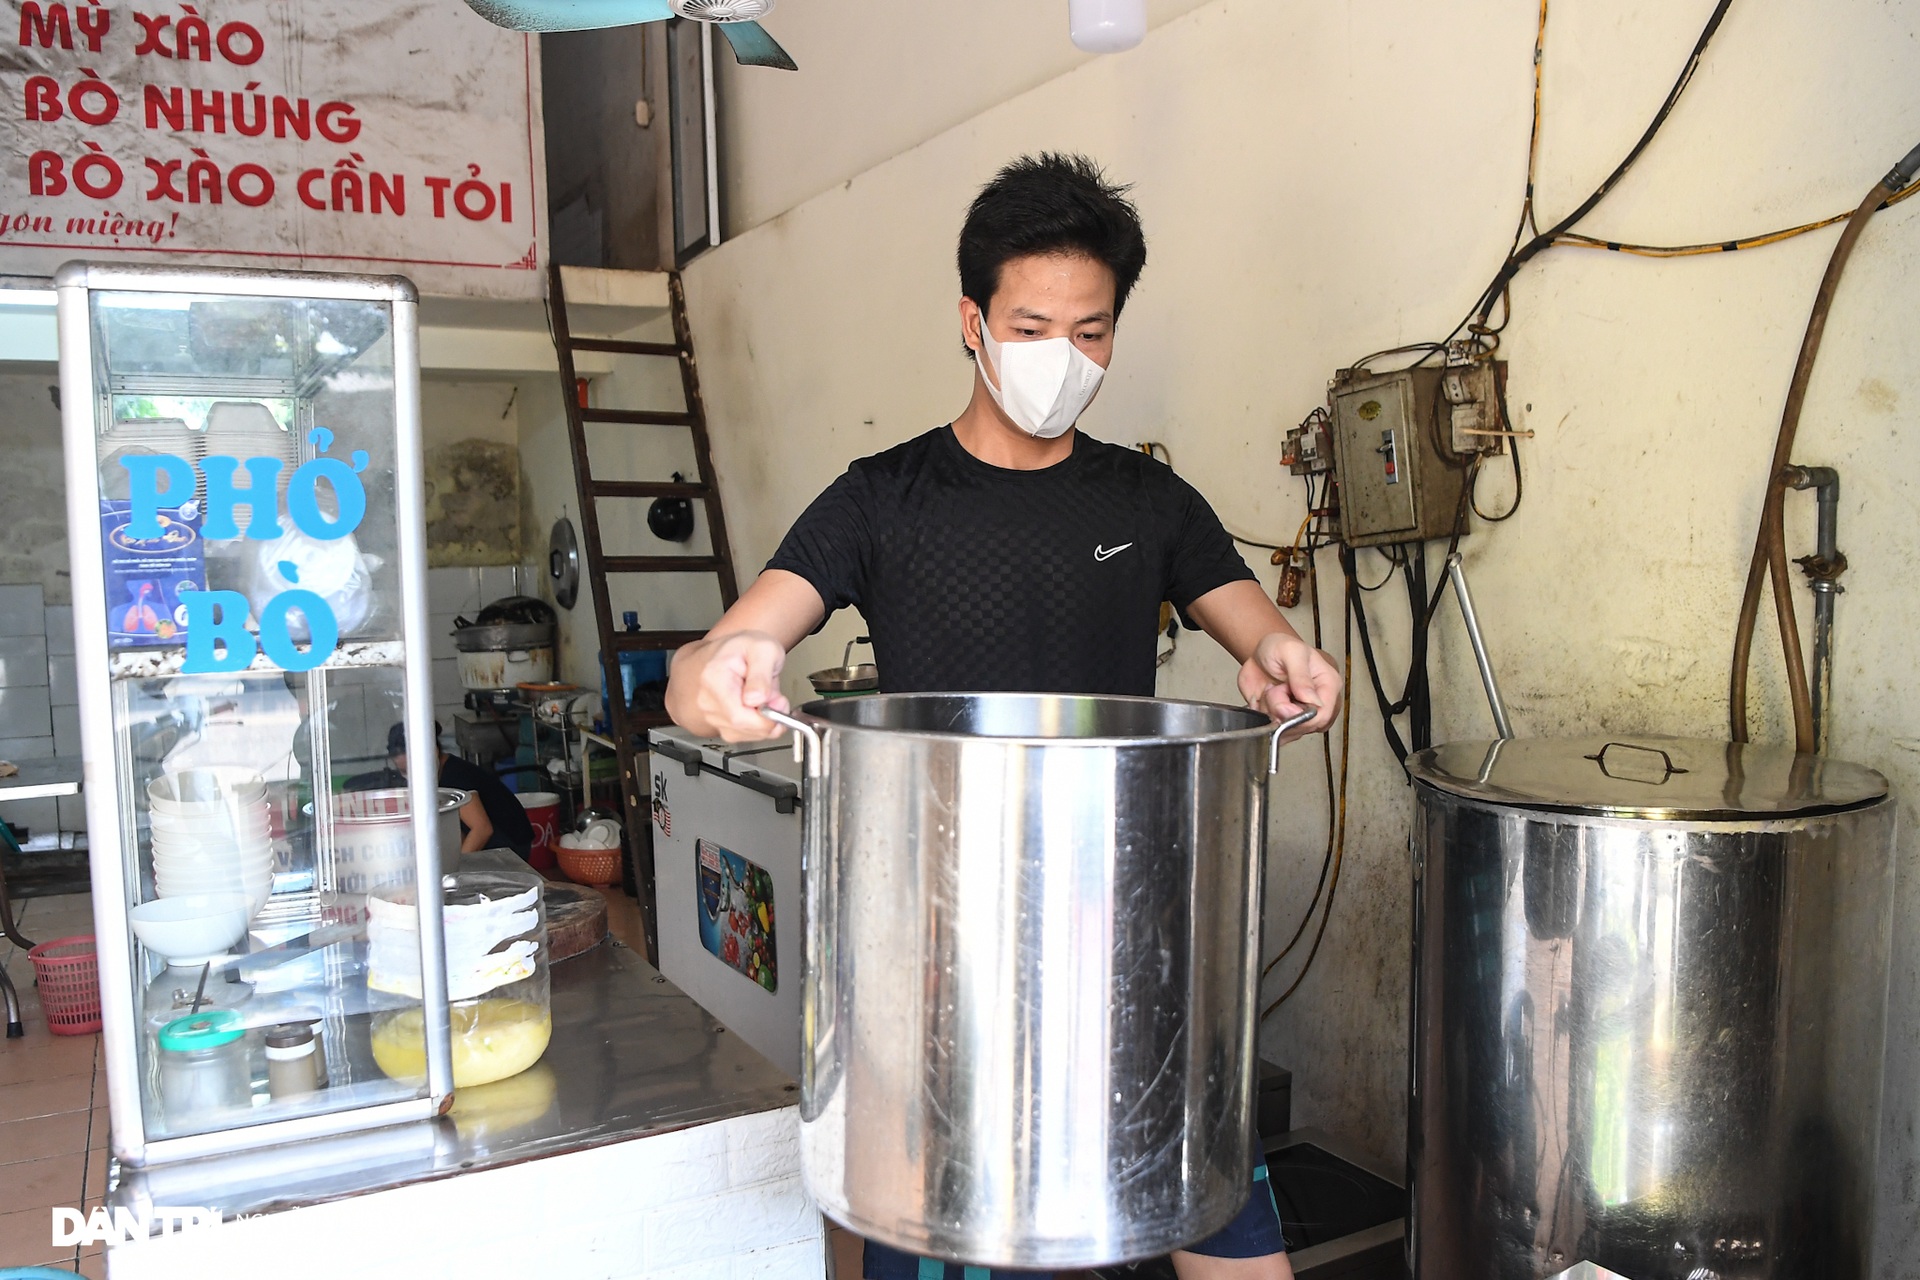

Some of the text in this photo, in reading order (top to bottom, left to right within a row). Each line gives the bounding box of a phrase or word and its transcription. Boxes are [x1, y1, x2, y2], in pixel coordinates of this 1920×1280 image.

[134, 4, 264, 66] XÀO
[25, 68, 361, 144] BÒ NHÚNG
[30, 142, 513, 224] BÒ XÀO CẦN TỎI
[66, 210, 179, 244] miệng!
[119, 427, 370, 541] PHỞ
[179, 560, 339, 674] BÒ
